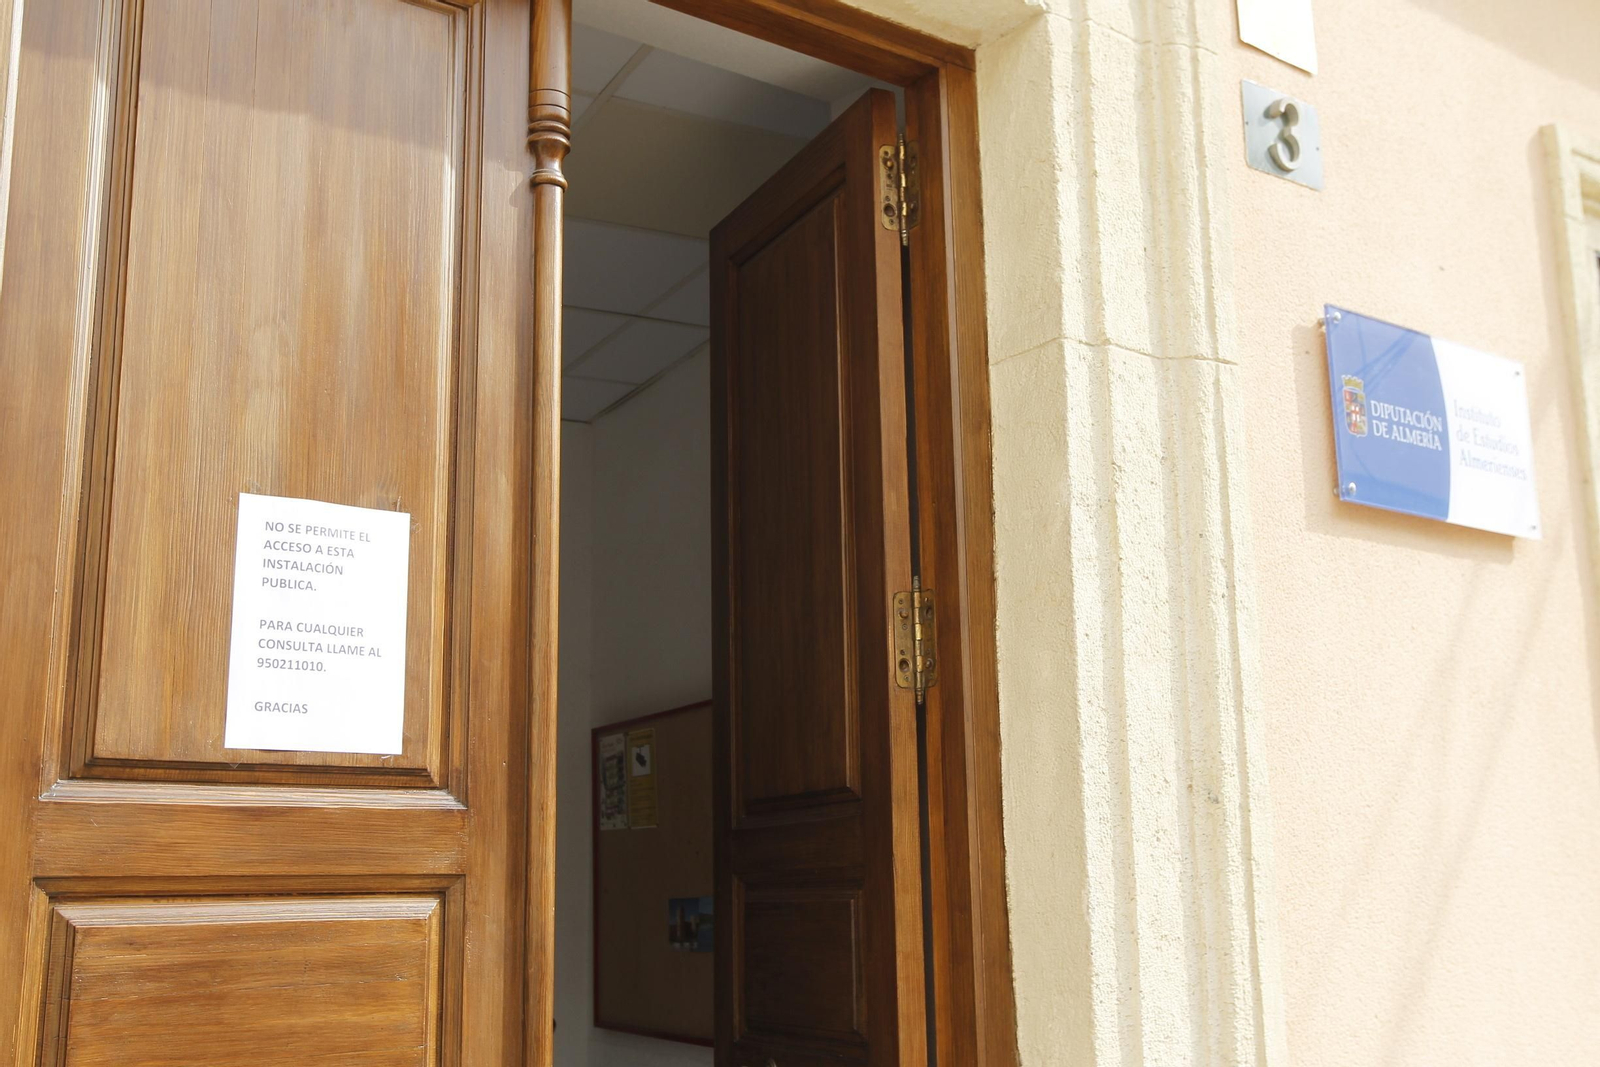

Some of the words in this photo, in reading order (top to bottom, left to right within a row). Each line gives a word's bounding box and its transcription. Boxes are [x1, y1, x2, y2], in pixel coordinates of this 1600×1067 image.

[1266, 97, 1301, 173] 3
[1370, 400, 1443, 432] DIPUTACIÓN
[1372, 420, 1390, 438] DE
[1391, 425, 1443, 451] ALMERÍA
[1456, 424, 1470, 444] de
[265, 521, 285, 533] NO
[287, 523, 302, 535] SE
[305, 525, 356, 541] PERMITE
[358, 532, 371, 543] EL
[263, 540, 312, 554] ACCESO
[315, 545, 324, 555] A
[326, 546, 355, 559] ESTA
[262, 558, 344, 576] INSTALACIÓN
[261, 577, 317, 592] PUBLICA.
[259, 619, 293, 632] PARA
[296, 622, 364, 638] CUALQUIER
[258, 638, 323, 653] CONSULTA
[326, 643, 365, 657] LLAME
[368, 647, 382, 658] AL
[256, 657, 327, 673] 950211010.
[254, 701, 308, 714] GRACIAS
